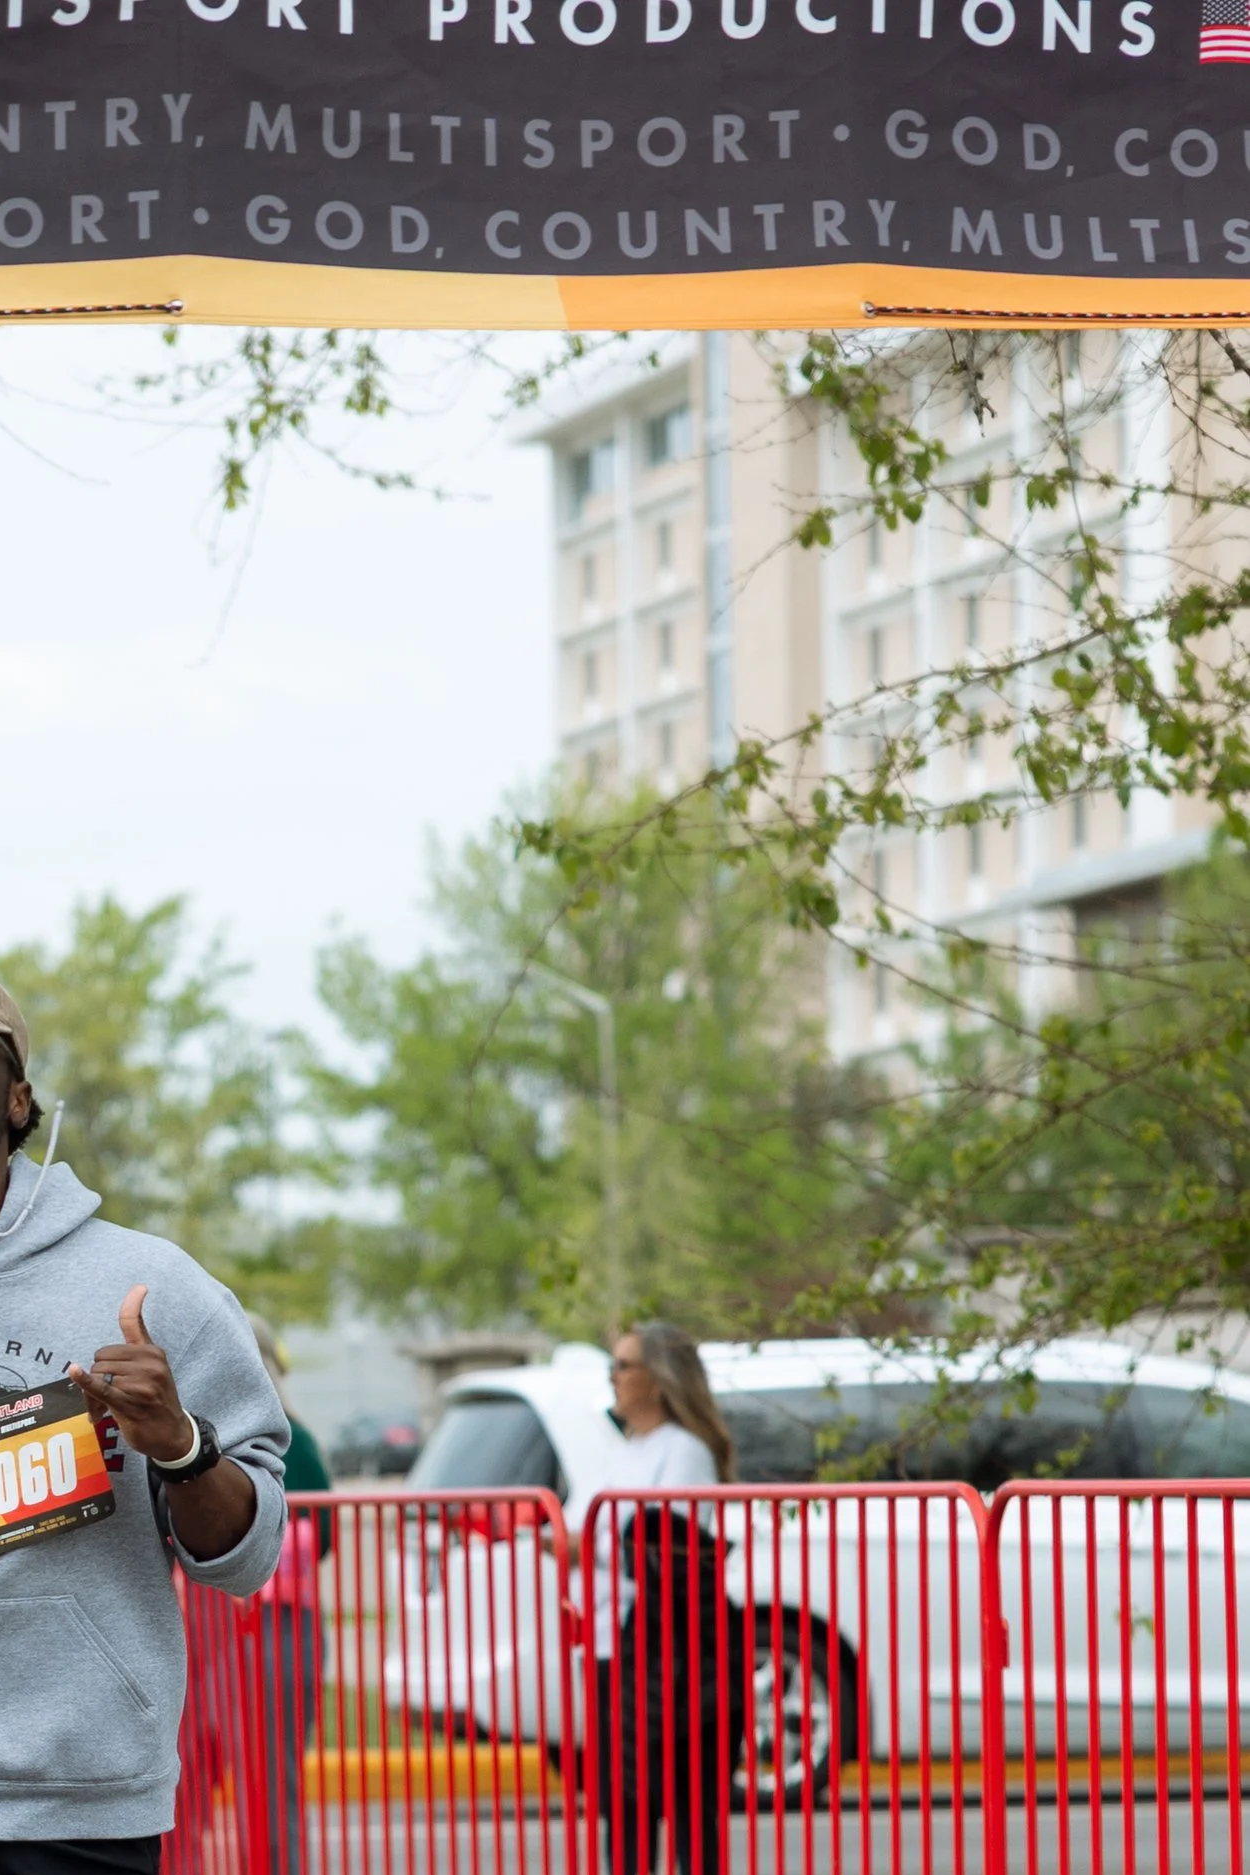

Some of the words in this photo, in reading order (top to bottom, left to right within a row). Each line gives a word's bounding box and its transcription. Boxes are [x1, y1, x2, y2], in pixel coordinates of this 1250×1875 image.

[428, 0, 1156, 58] PRODUCTIONS
[245, 101, 800, 169] MULTISPORT
[885, 109, 1075, 178] GOD,
[1114, 128, 1250, 178] CO
[245, 195, 444, 260] GOD,
[485, 199, 910, 261] COUNTRY,
